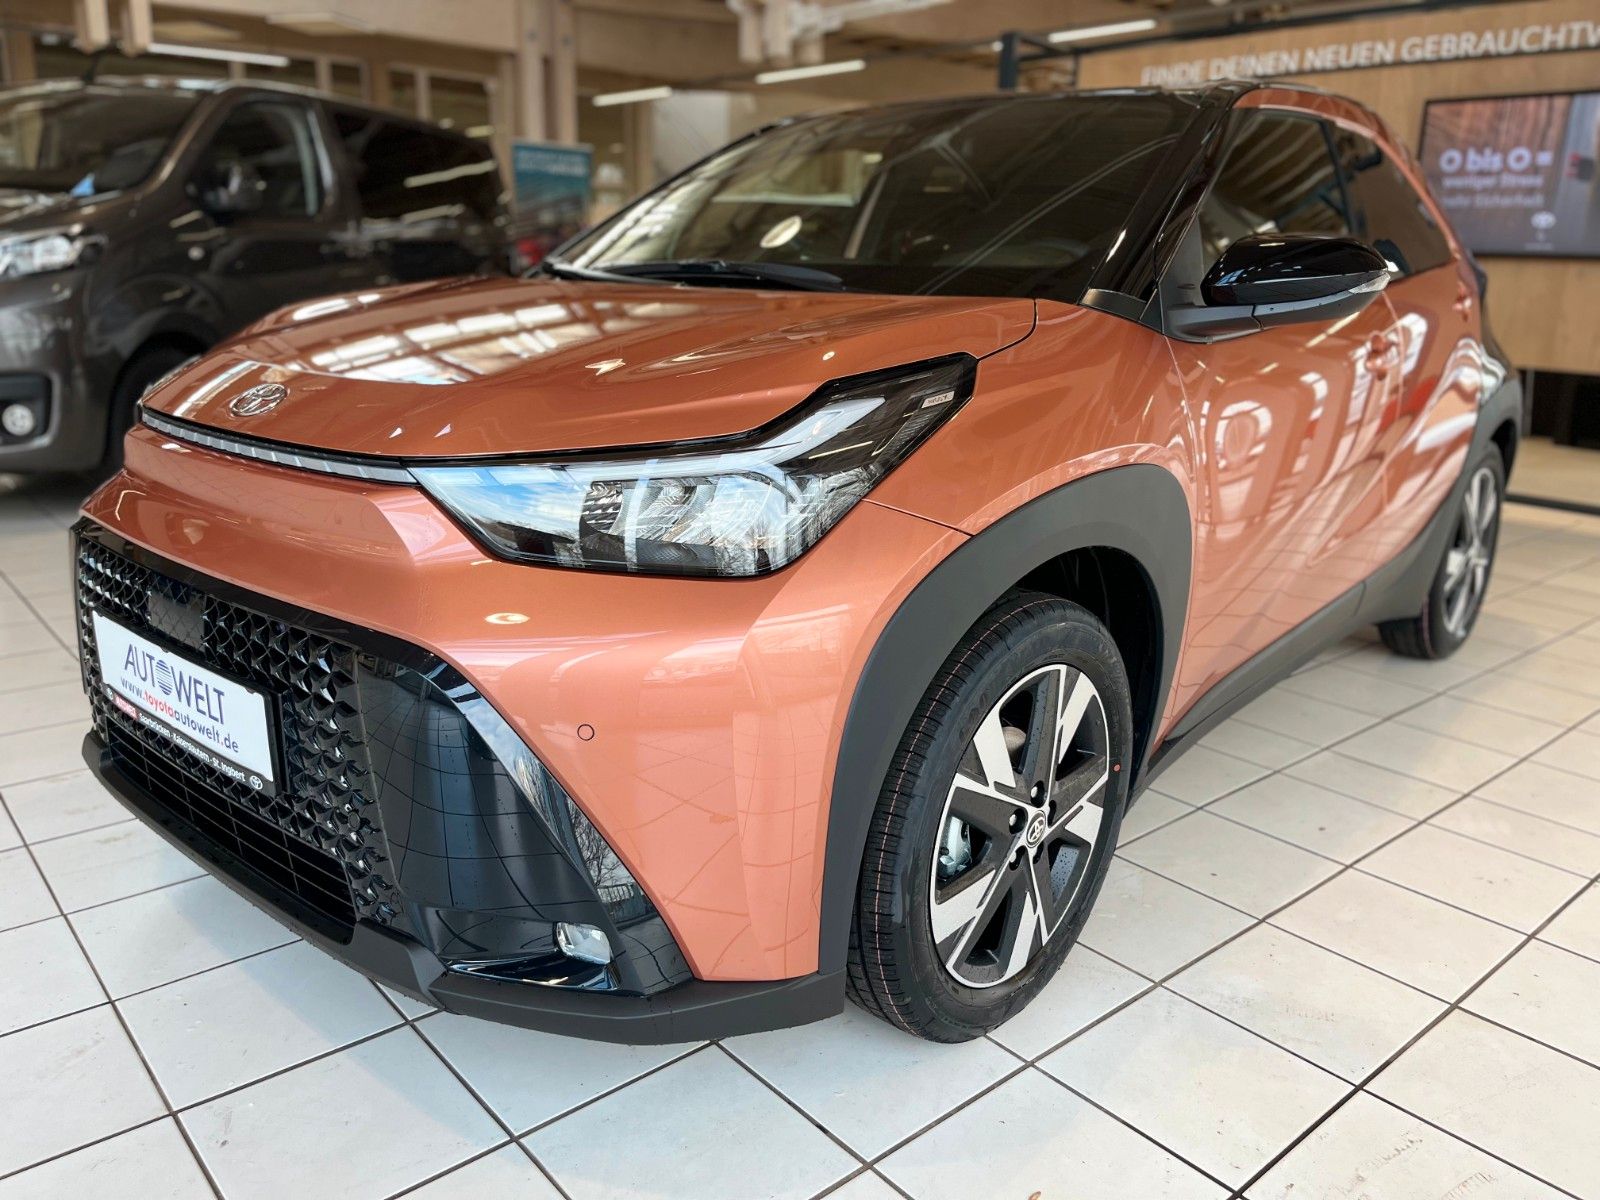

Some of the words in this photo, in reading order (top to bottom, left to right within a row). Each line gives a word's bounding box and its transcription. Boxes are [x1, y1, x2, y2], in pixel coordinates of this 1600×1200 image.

[1141, 59, 1207, 87] FINDE
[1208, 49, 1300, 81] DEINEN
[1303, 38, 1396, 72] NEUEN
[1466, 146, 1503, 172] bis
[124, 643, 225, 725] AUTOWELT
[121, 677, 239, 753] www.toyotaautowelt.de
[221, 762, 246, 782] Ingbert
